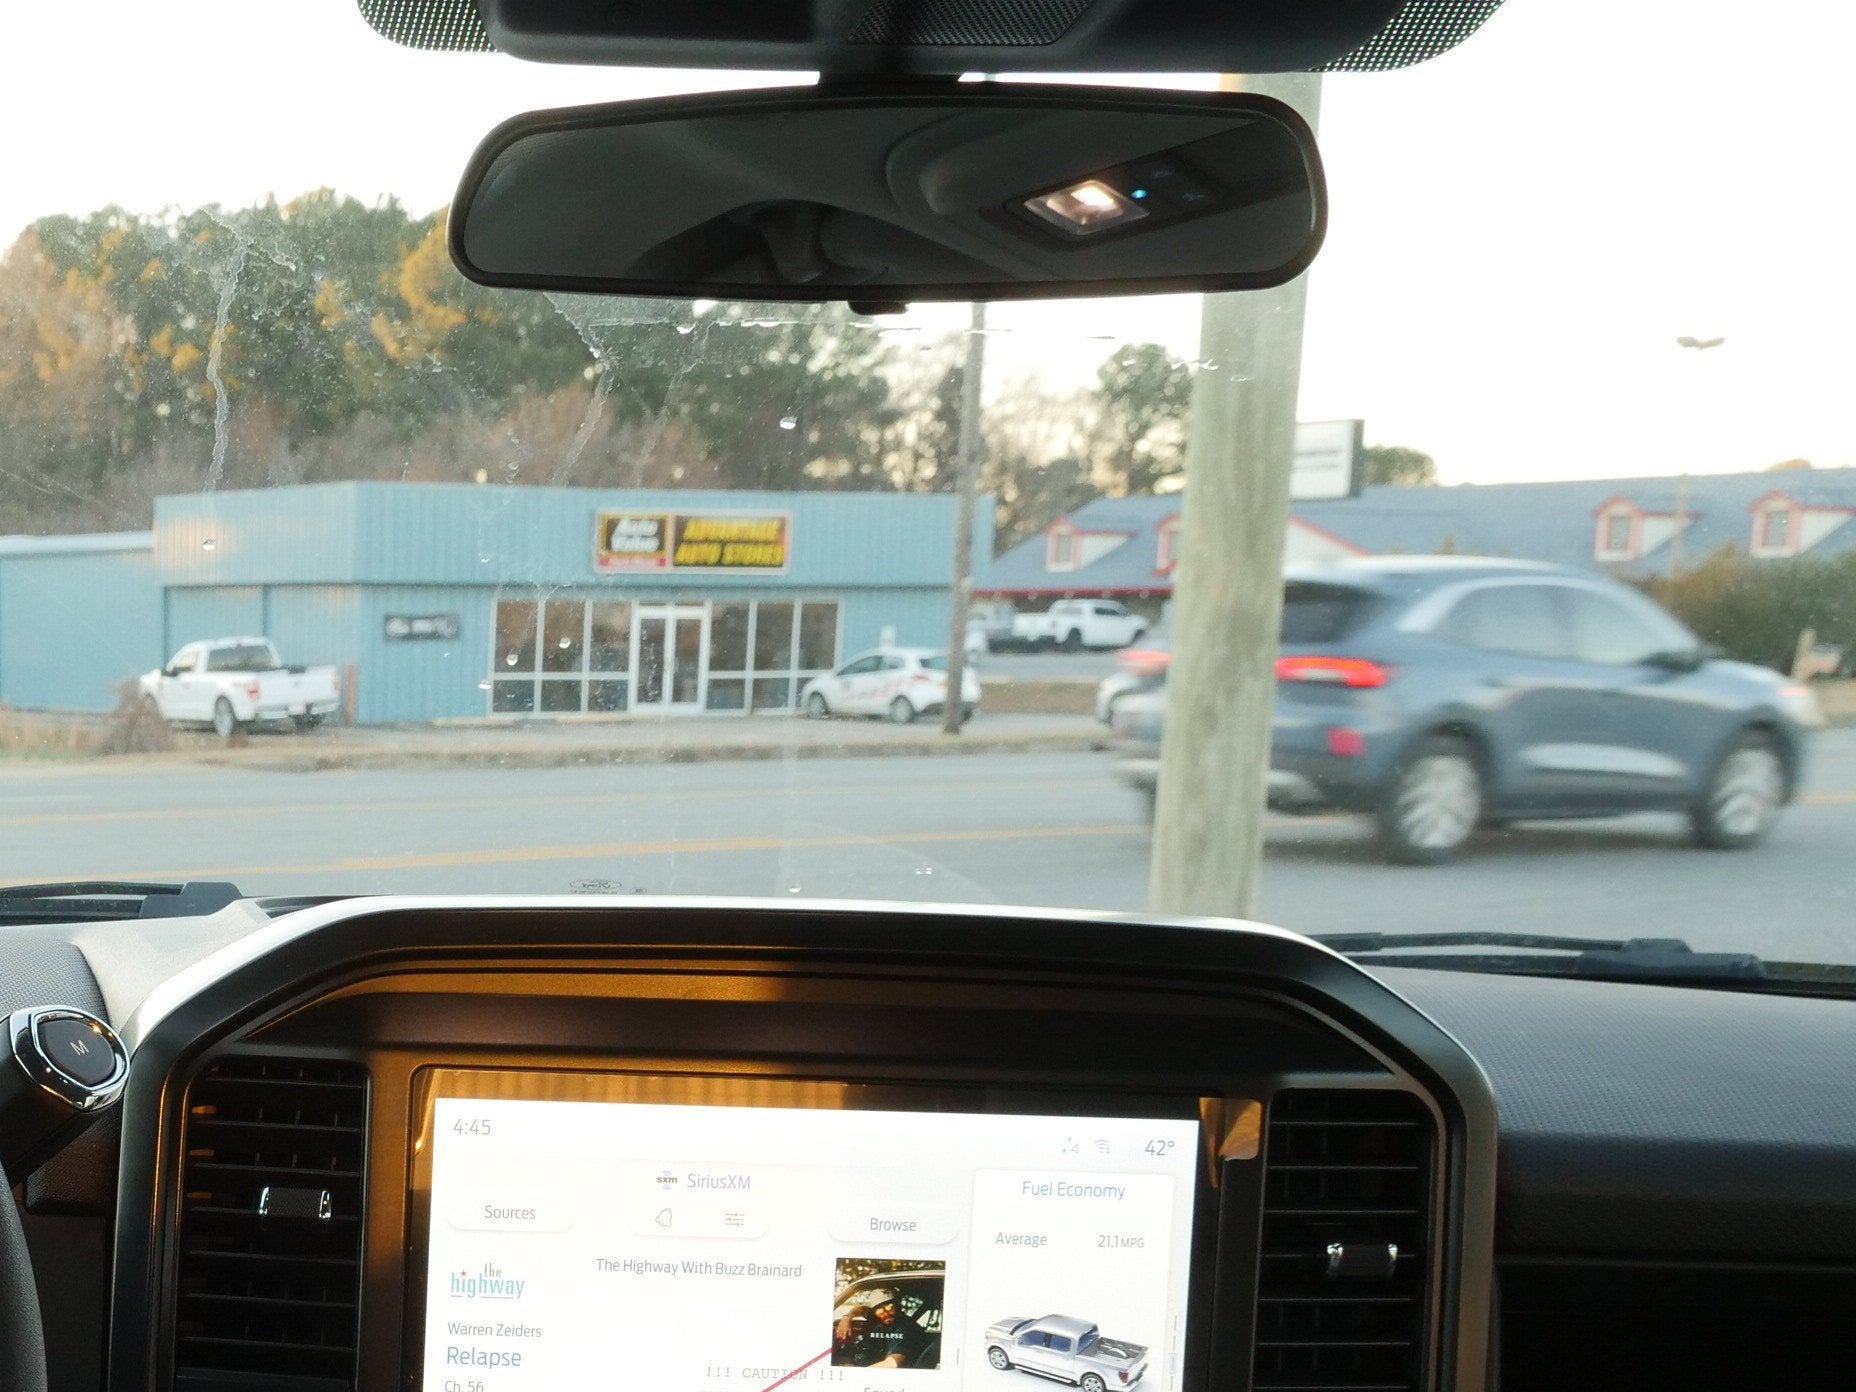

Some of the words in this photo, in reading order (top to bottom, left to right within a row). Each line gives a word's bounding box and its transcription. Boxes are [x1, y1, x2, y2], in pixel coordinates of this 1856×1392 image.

[70, 1039, 89, 1056] M
[453, 1119, 491, 1136] 4:45
[687, 1173, 751, 1190] SiriusXM
[1022, 1181, 1052, 1196] Fuel
[1057, 1182, 1125, 1200] Economy
[484, 1206, 536, 1220] Sources
[870, 1218, 916, 1232] Browse
[995, 1232, 1047, 1249] Average
[484, 1263, 502, 1278] the
[597, 1258, 620, 1272] The
[623, 1259, 678, 1275] Highway
[681, 1260, 712, 1275] With
[716, 1262, 745, 1276] Buzz
[748, 1263, 802, 1277] Brainard
[451, 1272, 525, 1298] highway
[447, 1323, 493, 1336] Warren
[496, 1324, 542, 1338] Zeiders
[870, 1332, 904, 1340] RELAPSE
[447, 1346, 522, 1369] Relapse
